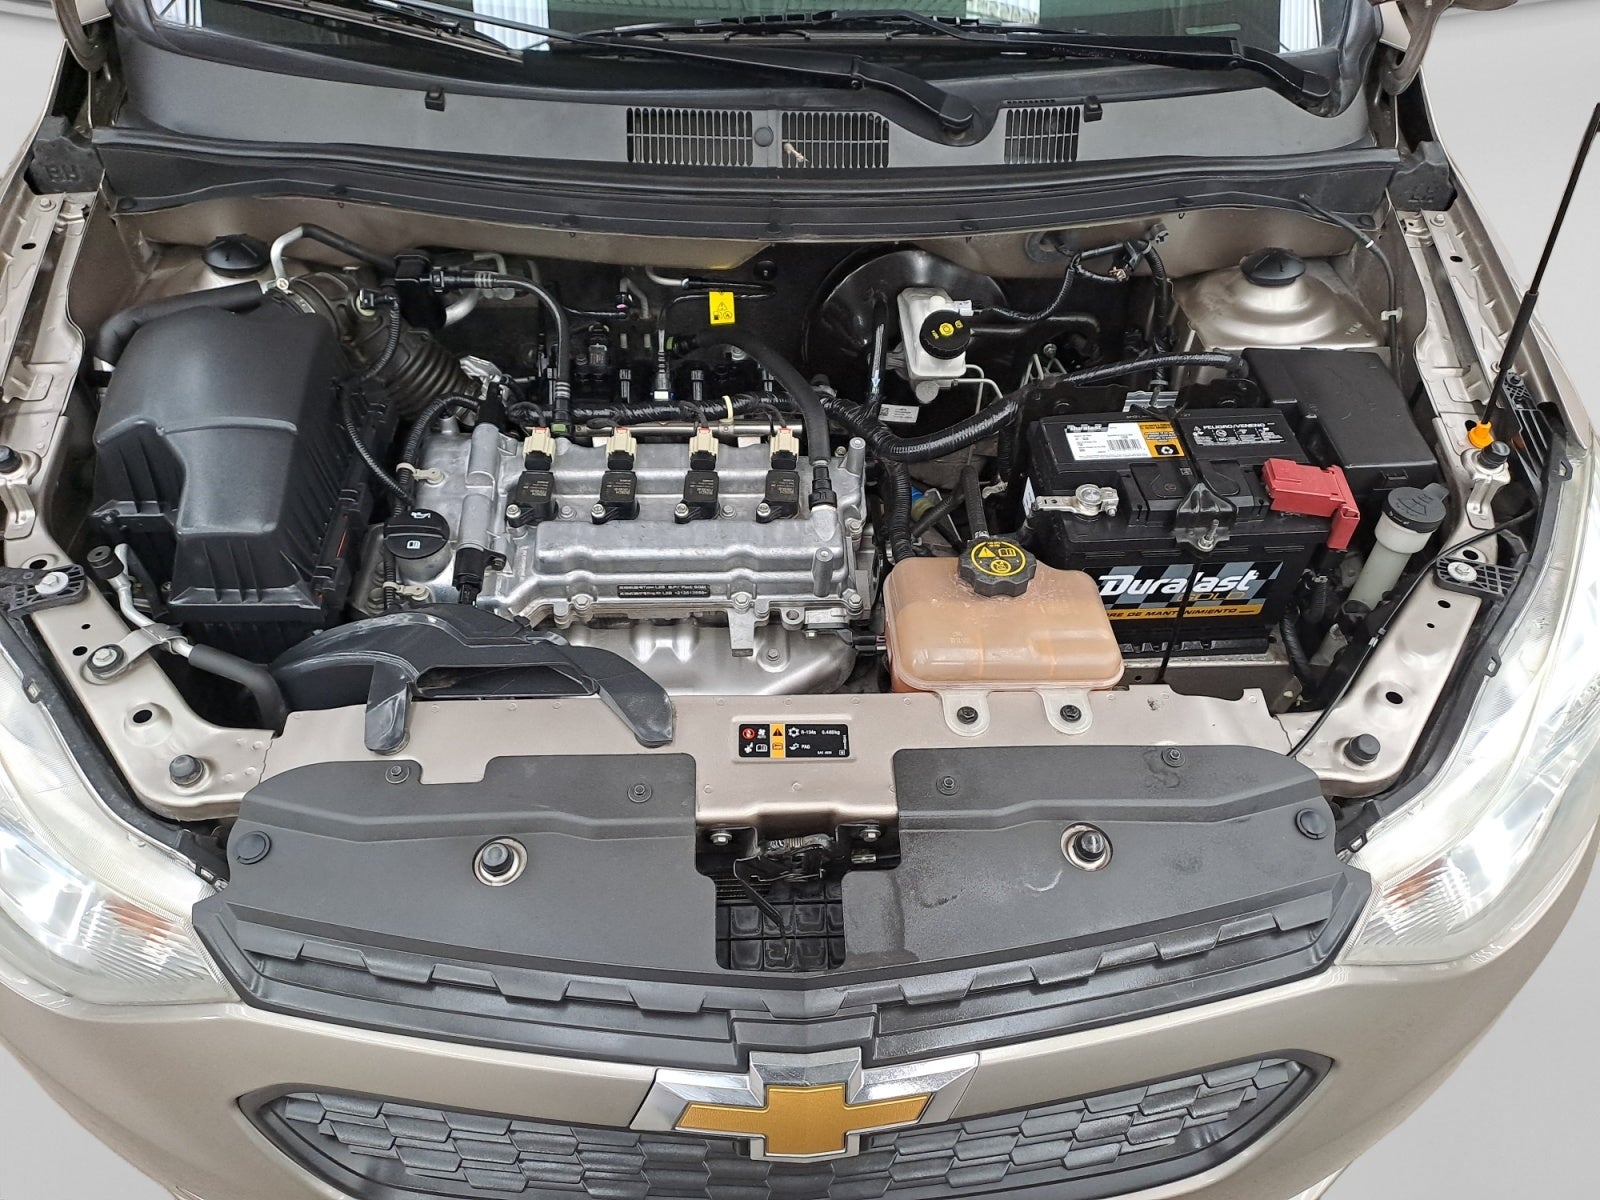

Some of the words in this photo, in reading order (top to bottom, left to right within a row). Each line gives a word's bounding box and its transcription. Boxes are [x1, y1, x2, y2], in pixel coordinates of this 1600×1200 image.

[1098, 569, 1259, 596] Duralast
[1176, 591, 1246, 602] GOLD
[1145, 608, 1238, 617] MANTNIMIENTO
